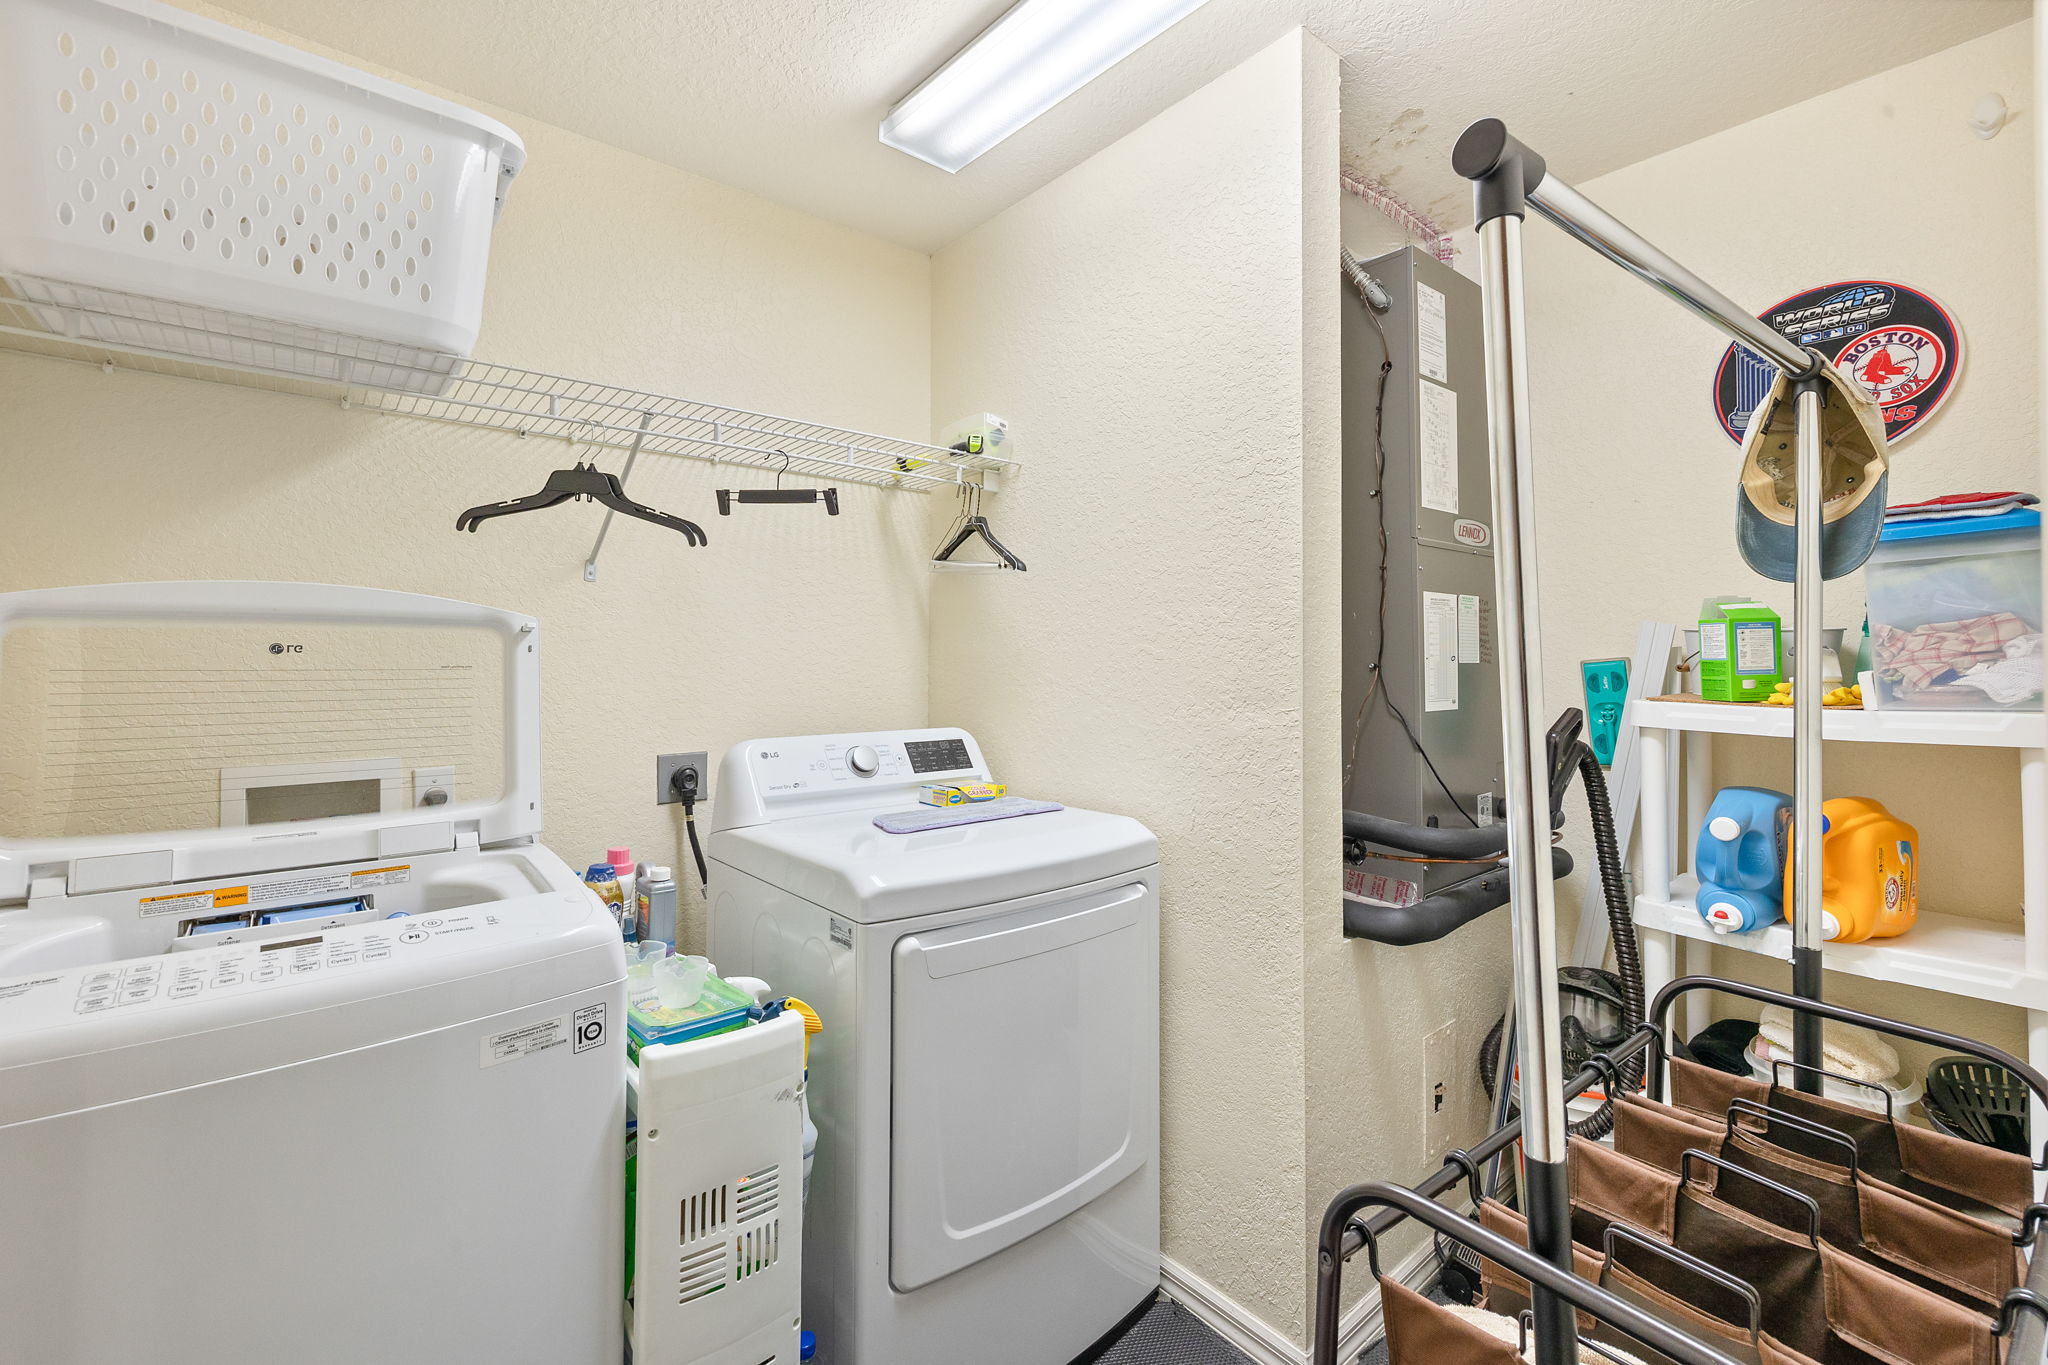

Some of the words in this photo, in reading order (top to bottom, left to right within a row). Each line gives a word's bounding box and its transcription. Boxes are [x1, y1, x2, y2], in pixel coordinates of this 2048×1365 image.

[1775, 293, 1885, 327] WORLD
[1784, 303, 1890, 334] SERIES
[1846, 324, 1863, 333] 04
[1842, 331, 1930, 365] BOSTON
[1890, 373, 1928, 400] SOX
[1458, 524, 1482, 540] LENNOX
[221, 892, 247, 900] WARNING
[320, 923, 346, 931] Detergent
[217, 939, 241, 947] Softener
[576, 1011, 591, 1021] Direct
[590, 1008, 604, 1017] Drive
[576, 1021, 603, 1045] 10
[503, 1048, 519, 1056] CANADA
